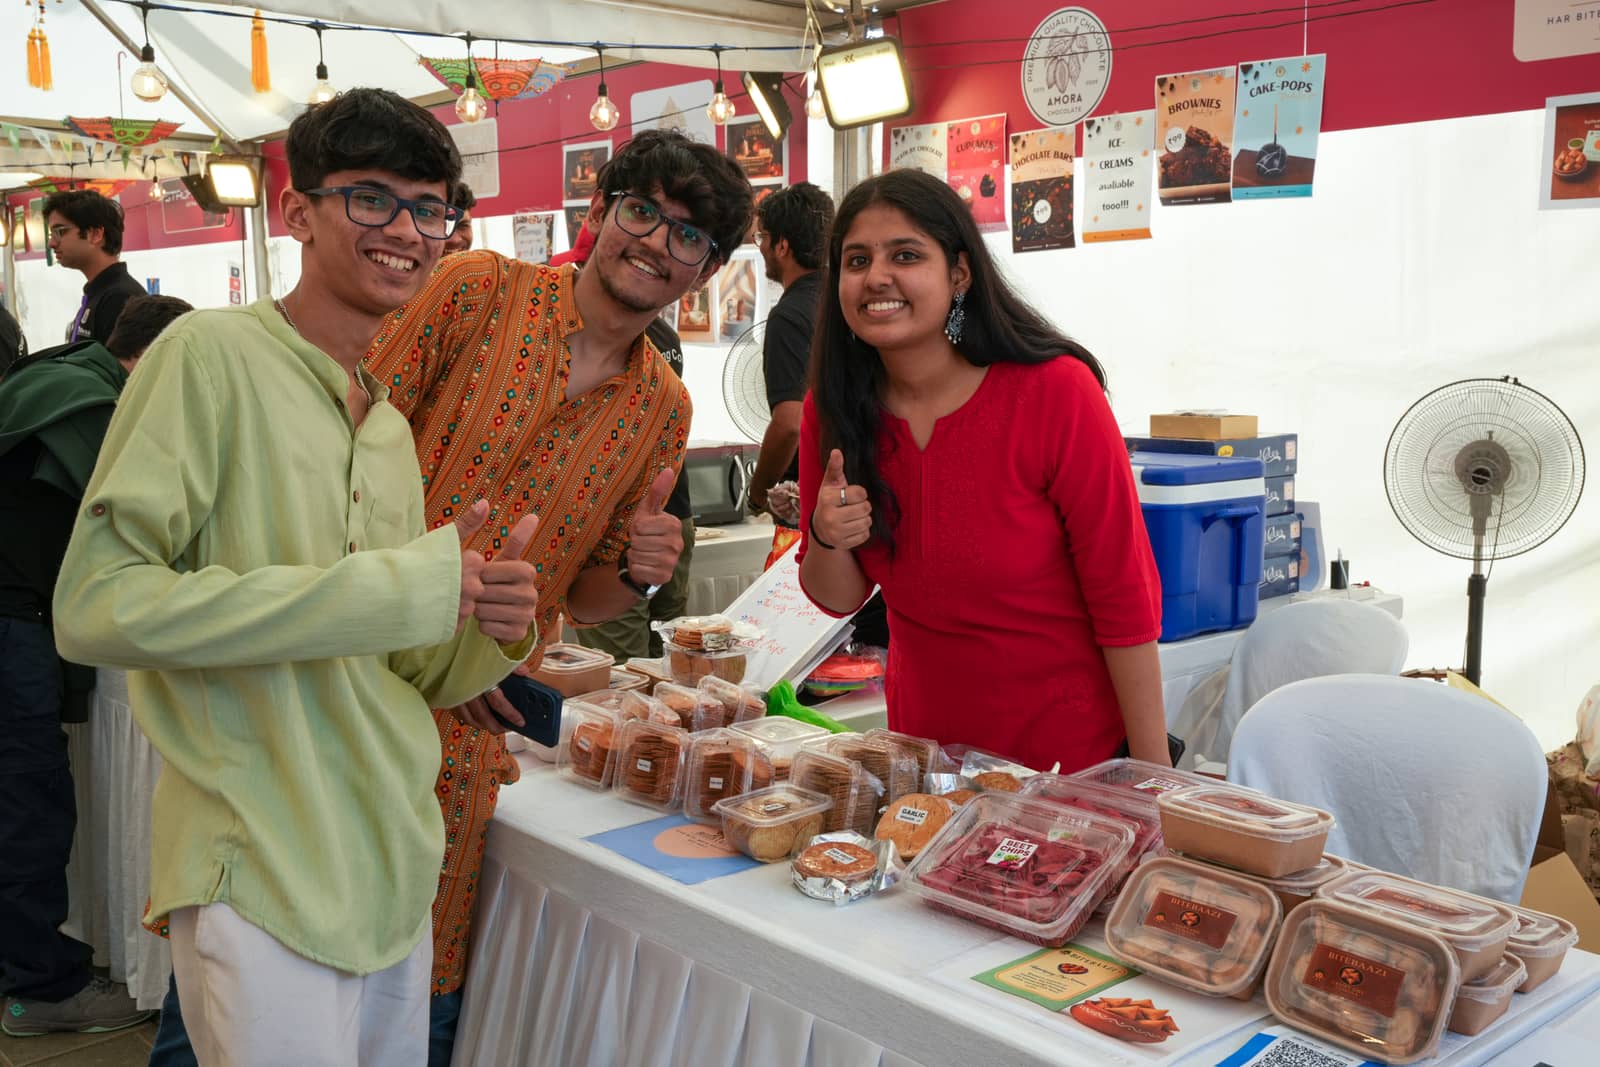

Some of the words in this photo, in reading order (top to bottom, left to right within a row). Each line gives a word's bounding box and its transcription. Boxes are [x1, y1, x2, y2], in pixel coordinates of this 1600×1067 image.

[1547, 14, 1571, 25] HAR
[1043, 15, 1079, 35] QUALITY
[1080, 17, 1106, 71] CHOCOLATE
[1249, 80, 1313, 98] CAKE-POPS
[1047, 93, 1083, 106] AMORA
[1168, 97, 1222, 115] BROWNIES
[1047, 106, 1082, 116] CHOCOLATE
[1012, 150, 1050, 172] CHOCOLATE
[1053, 149, 1073, 164] BARS
[1099, 157, 1134, 170] CREAMS
[1102, 199, 1129, 211] tooo!!!
[902, 808, 926, 818] GARLIC
[1000, 845, 1031, 857] CHIPS
[1006, 840, 1033, 850] BEET
[1171, 897, 1223, 919] BITEBAAZI
[1328, 951, 1387, 977] BITEBAAZI
